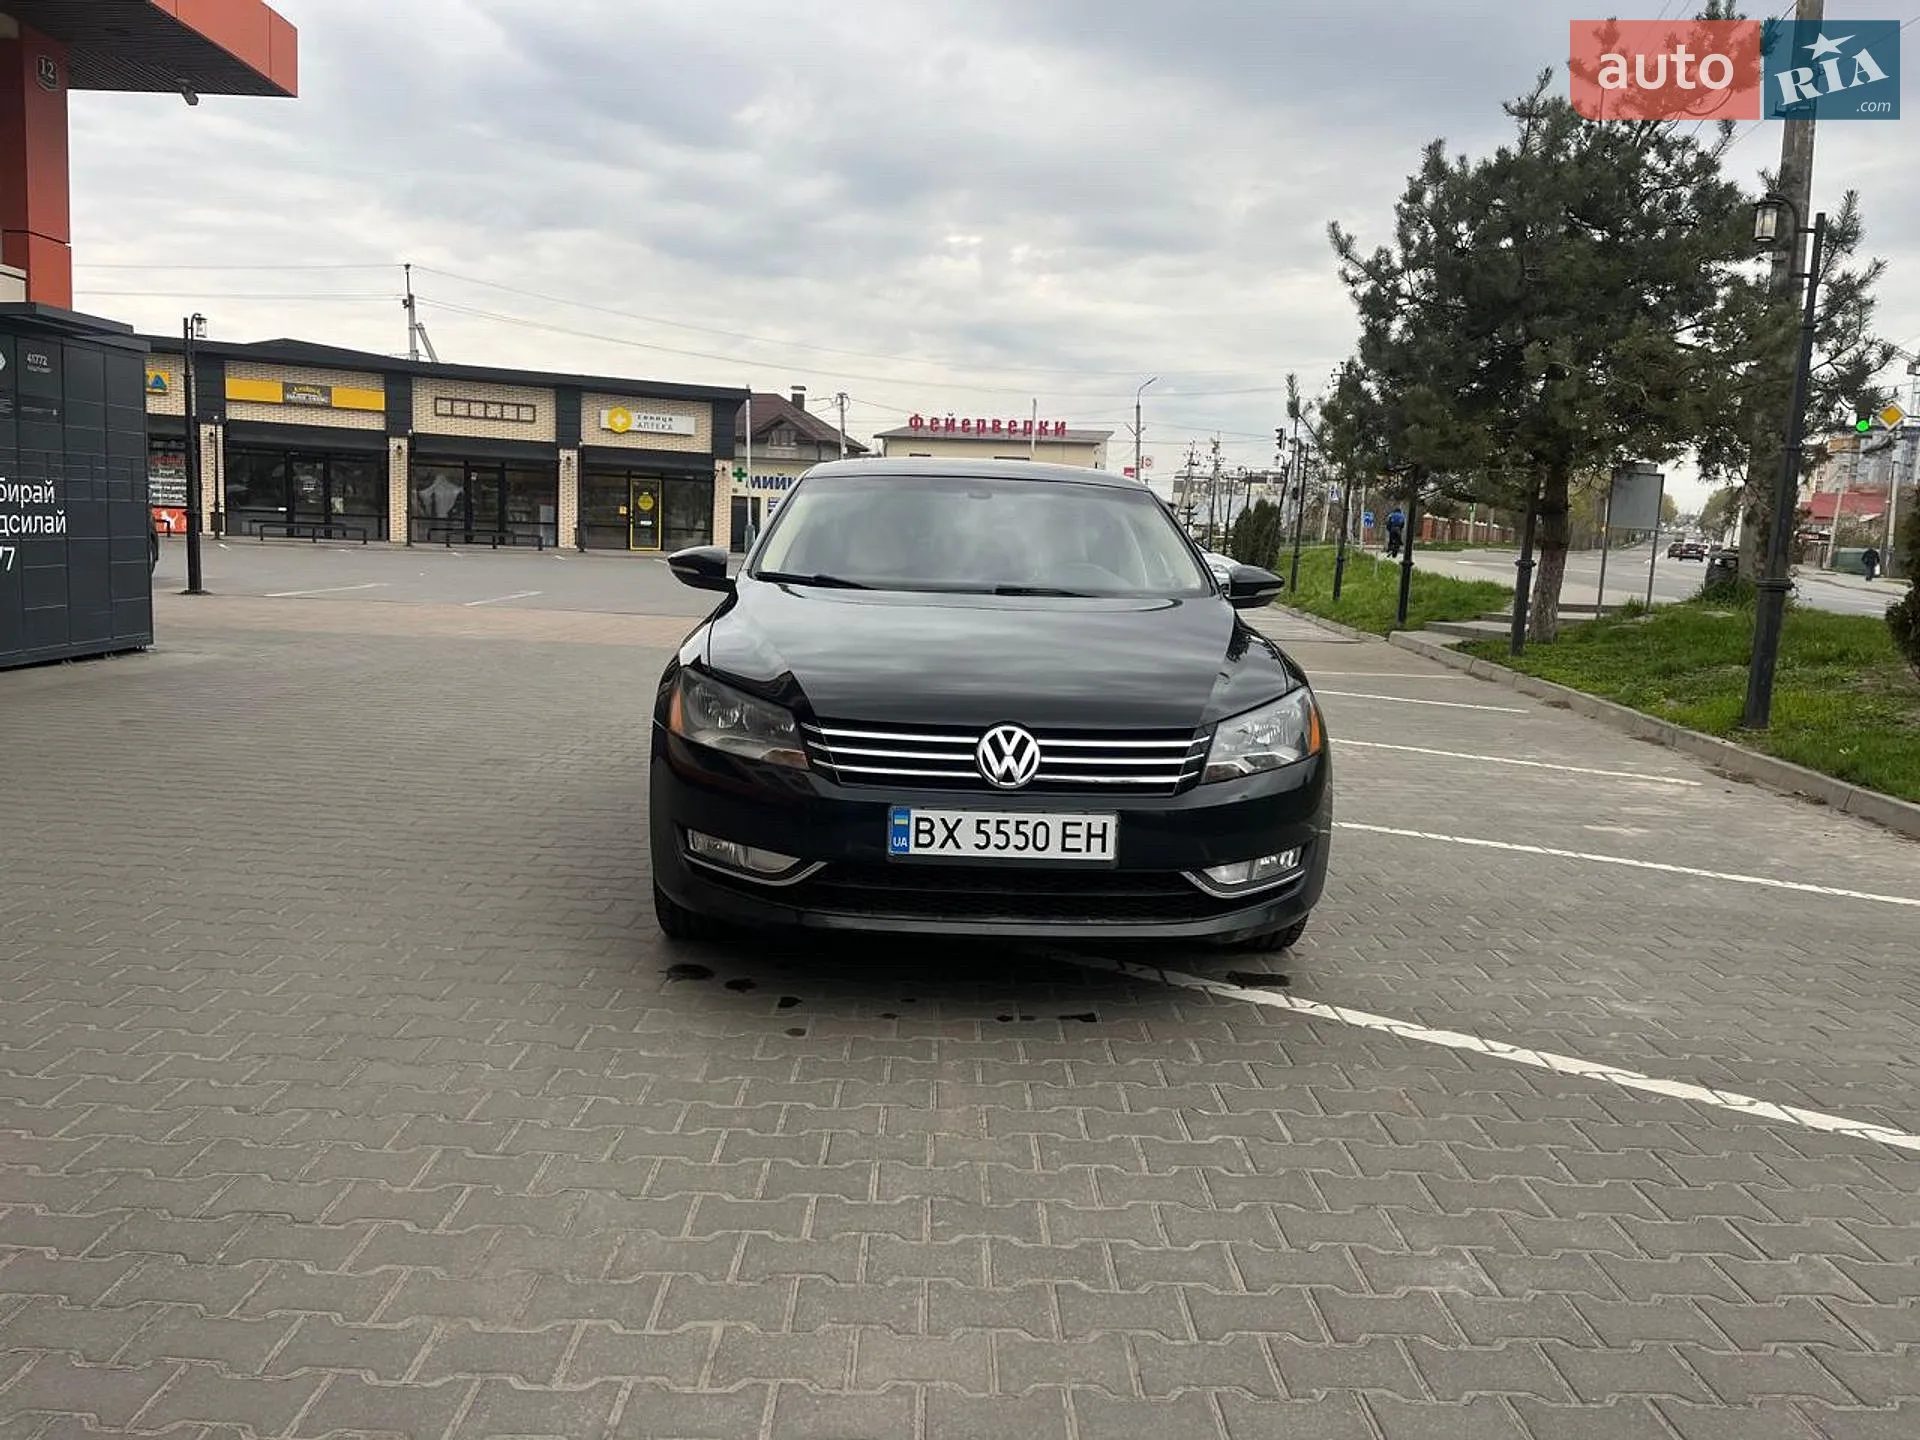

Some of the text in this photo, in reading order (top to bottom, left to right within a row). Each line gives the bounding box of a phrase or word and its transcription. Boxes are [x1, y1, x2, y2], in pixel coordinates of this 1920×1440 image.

[40, 59, 54, 80] 12
[637, 421, 673, 430] АПТЕКА
[908, 412, 1067, 436] Фейерверки
[0, 546, 15, 571] 7
[892, 836, 908, 848] UA
[914, 816, 1107, 853] BX 5550 EH
